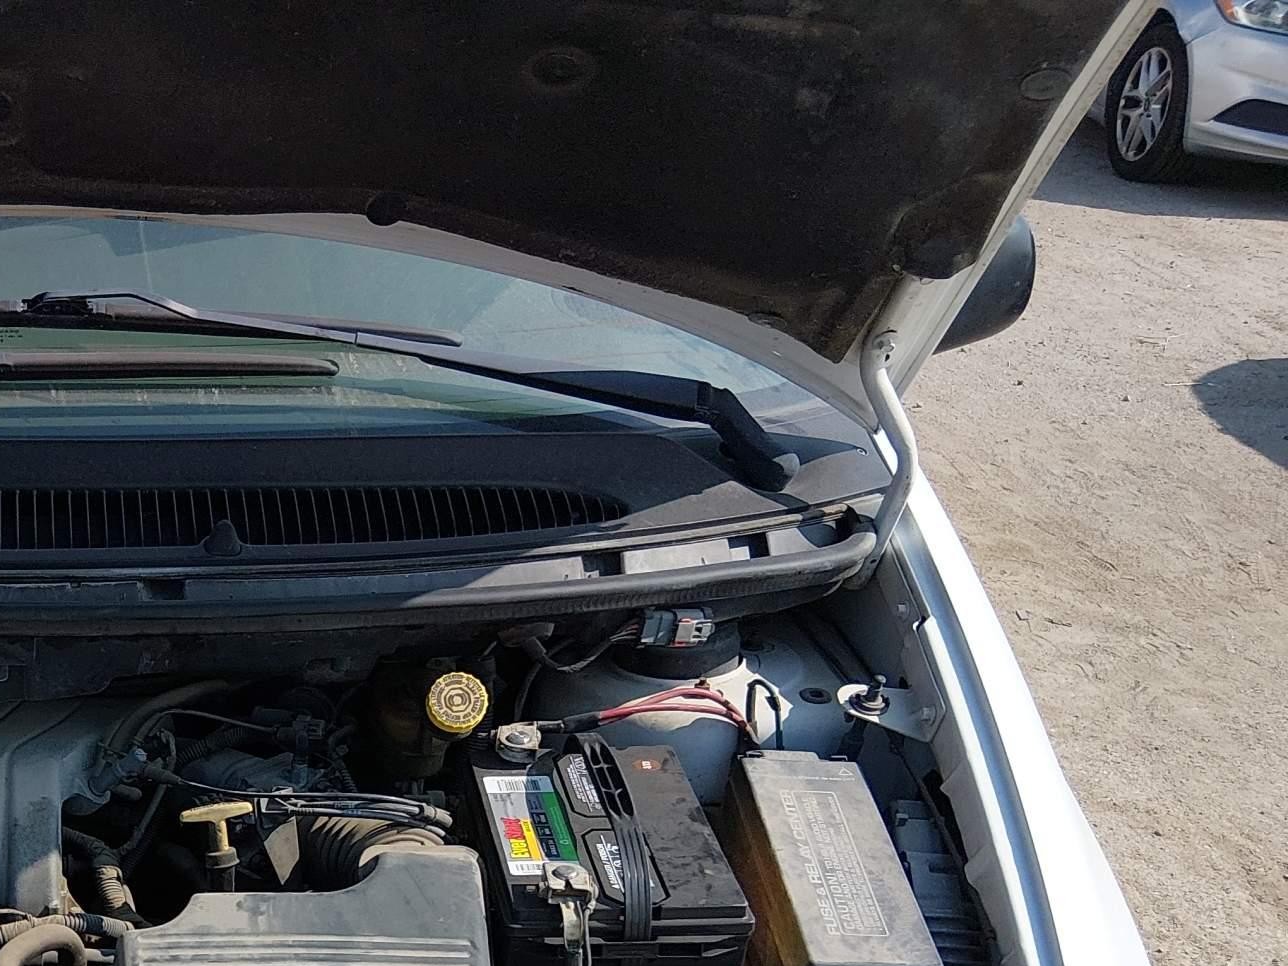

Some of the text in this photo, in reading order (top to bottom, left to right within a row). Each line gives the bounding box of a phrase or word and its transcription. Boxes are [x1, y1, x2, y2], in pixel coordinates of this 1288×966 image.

[779, 789, 806, 839] CENTER
[799, 843, 822, 883] RELAY
[816, 899, 840, 935] FUSE
